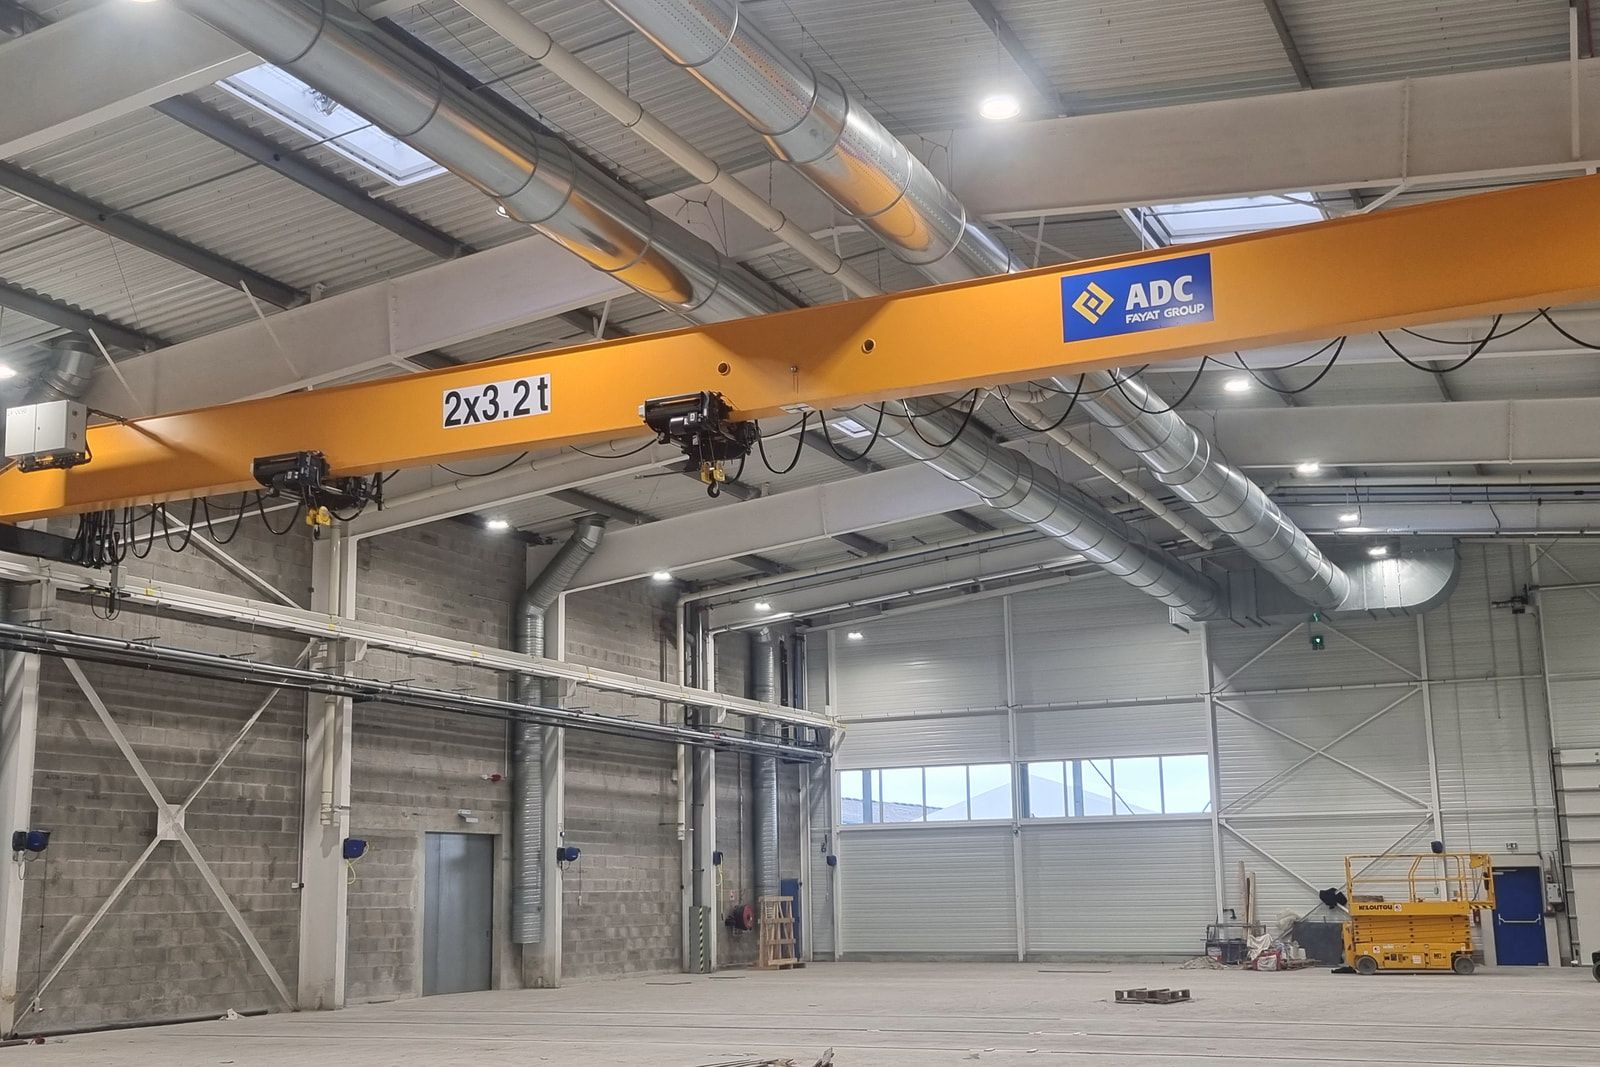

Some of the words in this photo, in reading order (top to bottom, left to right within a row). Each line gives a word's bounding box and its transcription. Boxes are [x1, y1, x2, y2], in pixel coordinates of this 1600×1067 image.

[1125, 275, 1193, 310] ADC
[1125, 310, 1160, 324] FAYAT
[1164, 303, 1205, 318] GROUP
[444, 379, 530, 427] 2x3.2
